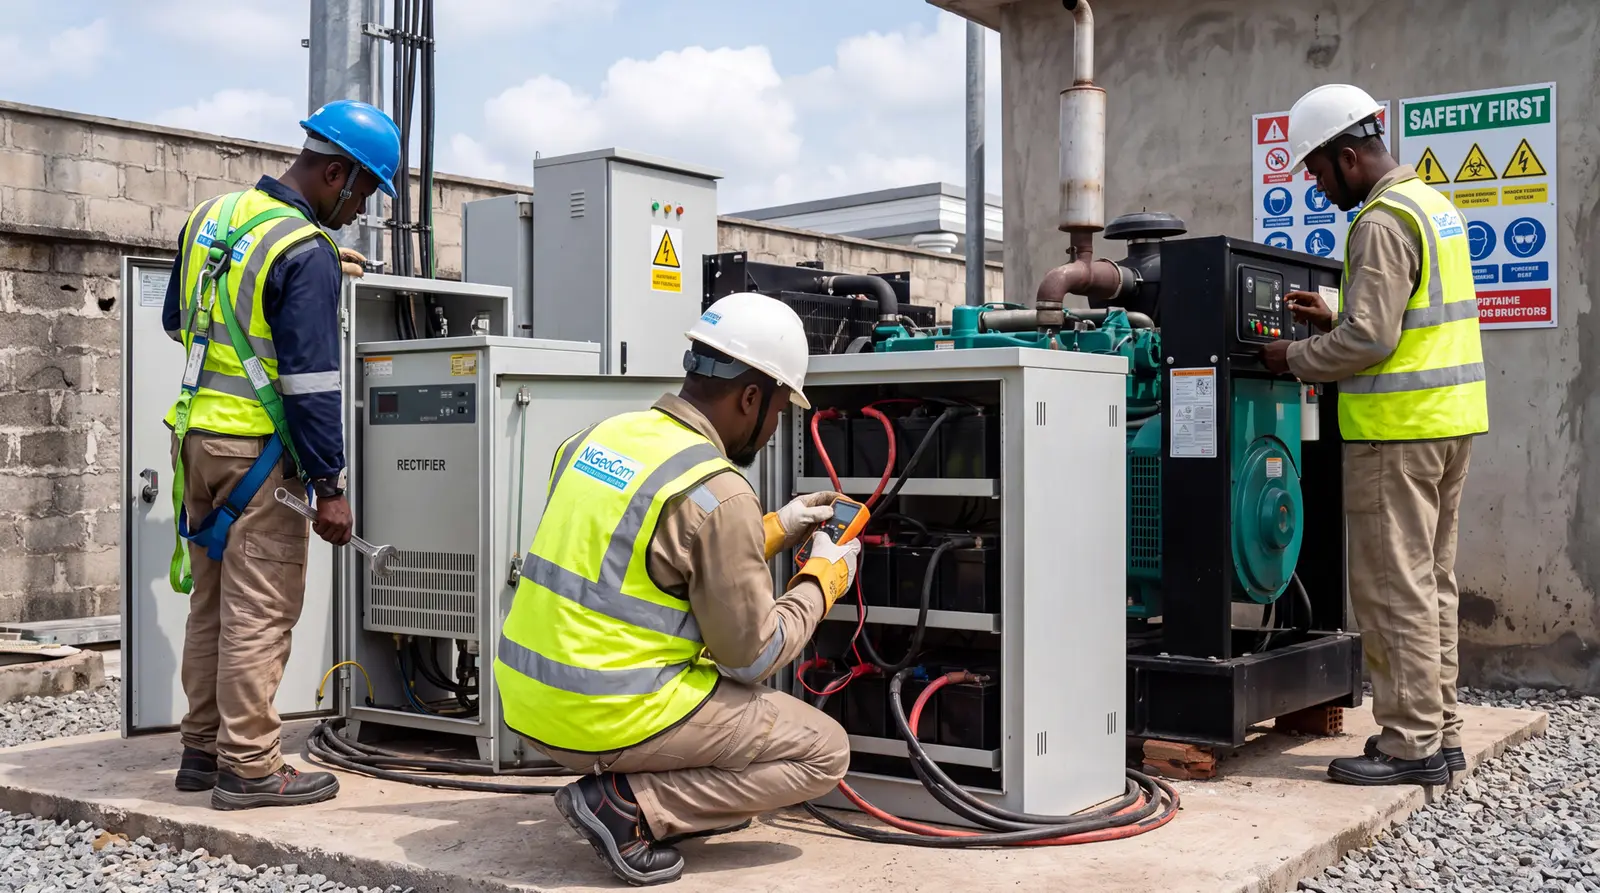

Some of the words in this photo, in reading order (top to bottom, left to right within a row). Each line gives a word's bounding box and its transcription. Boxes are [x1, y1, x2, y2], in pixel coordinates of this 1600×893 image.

[1409, 102, 1482, 131] SAFETY
[1488, 95, 1545, 122] FIRST
[1495, 306, 1547, 318] BRUCTORS
[397, 459, 446, 471] RECTIFIER
[580, 446, 635, 480] NiGeoCom
